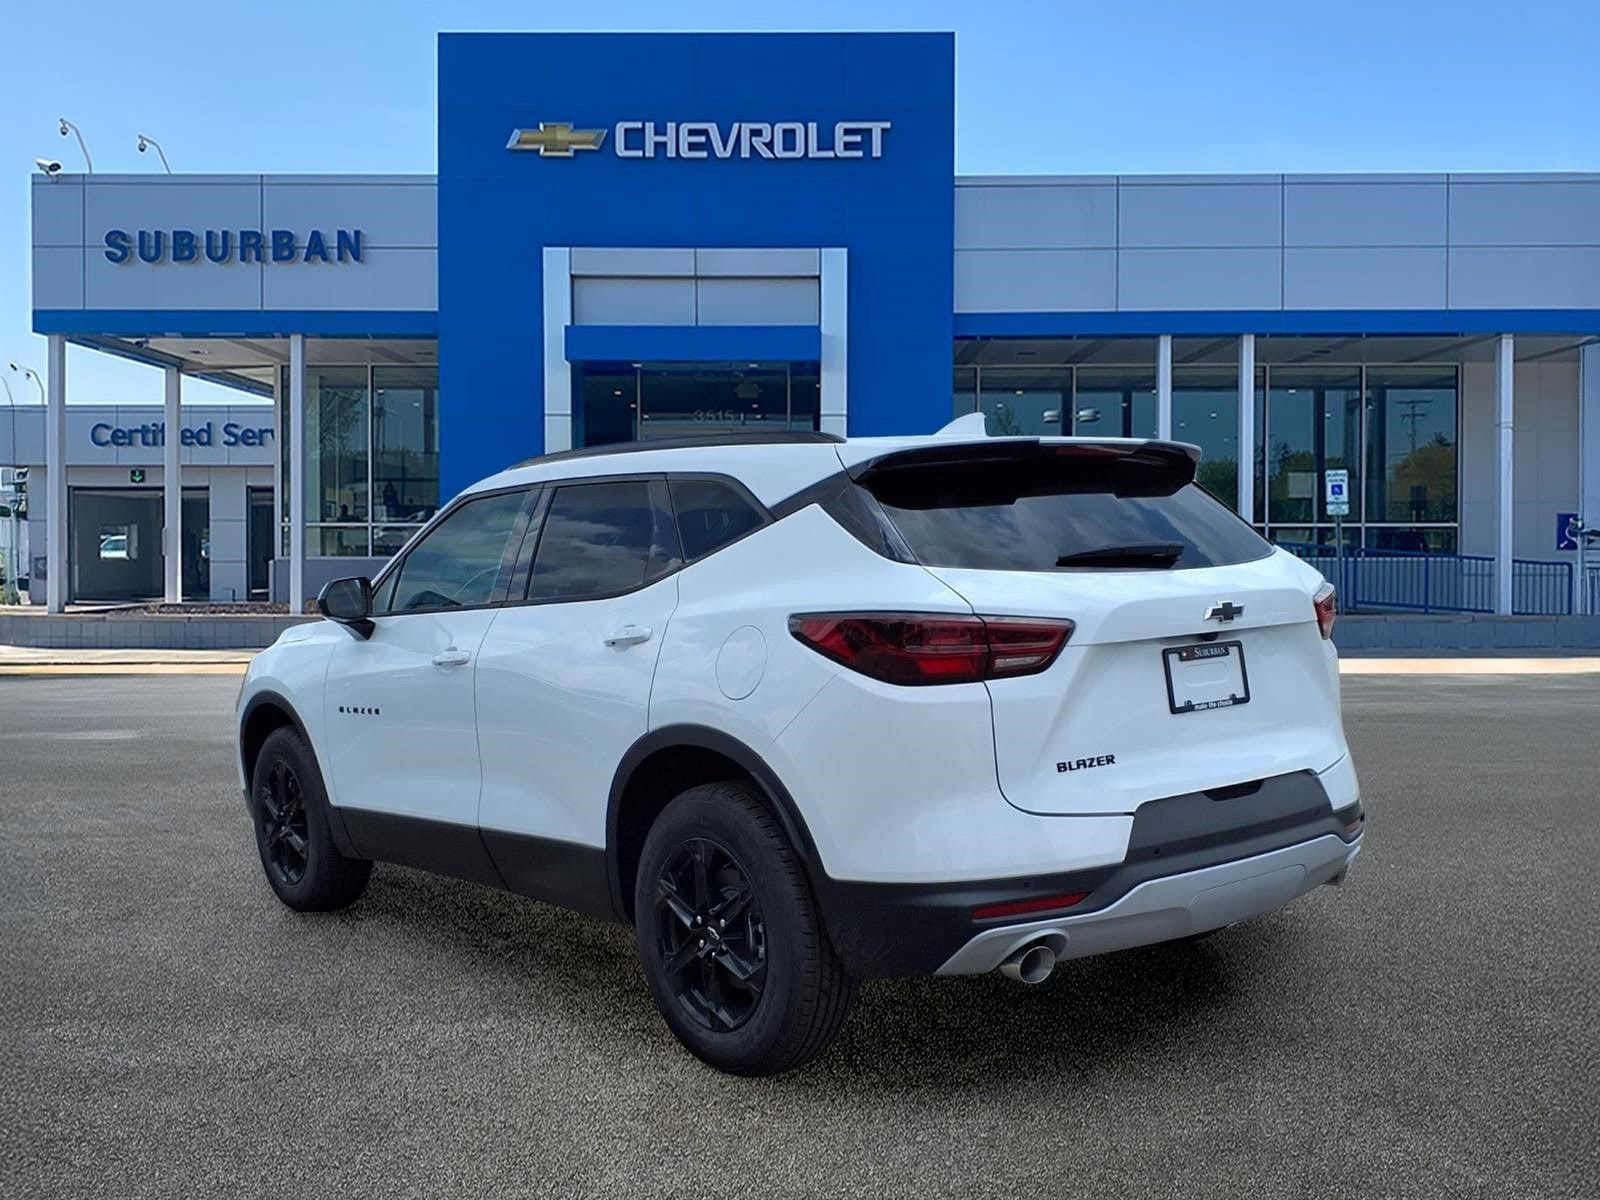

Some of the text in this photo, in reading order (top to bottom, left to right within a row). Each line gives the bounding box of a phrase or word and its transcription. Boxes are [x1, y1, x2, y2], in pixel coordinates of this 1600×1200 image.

[615, 121, 891, 158] CHEVROLET
[104, 230, 363, 263] SUBURBAN
[1056, 754, 1116, 773] BLAZER
